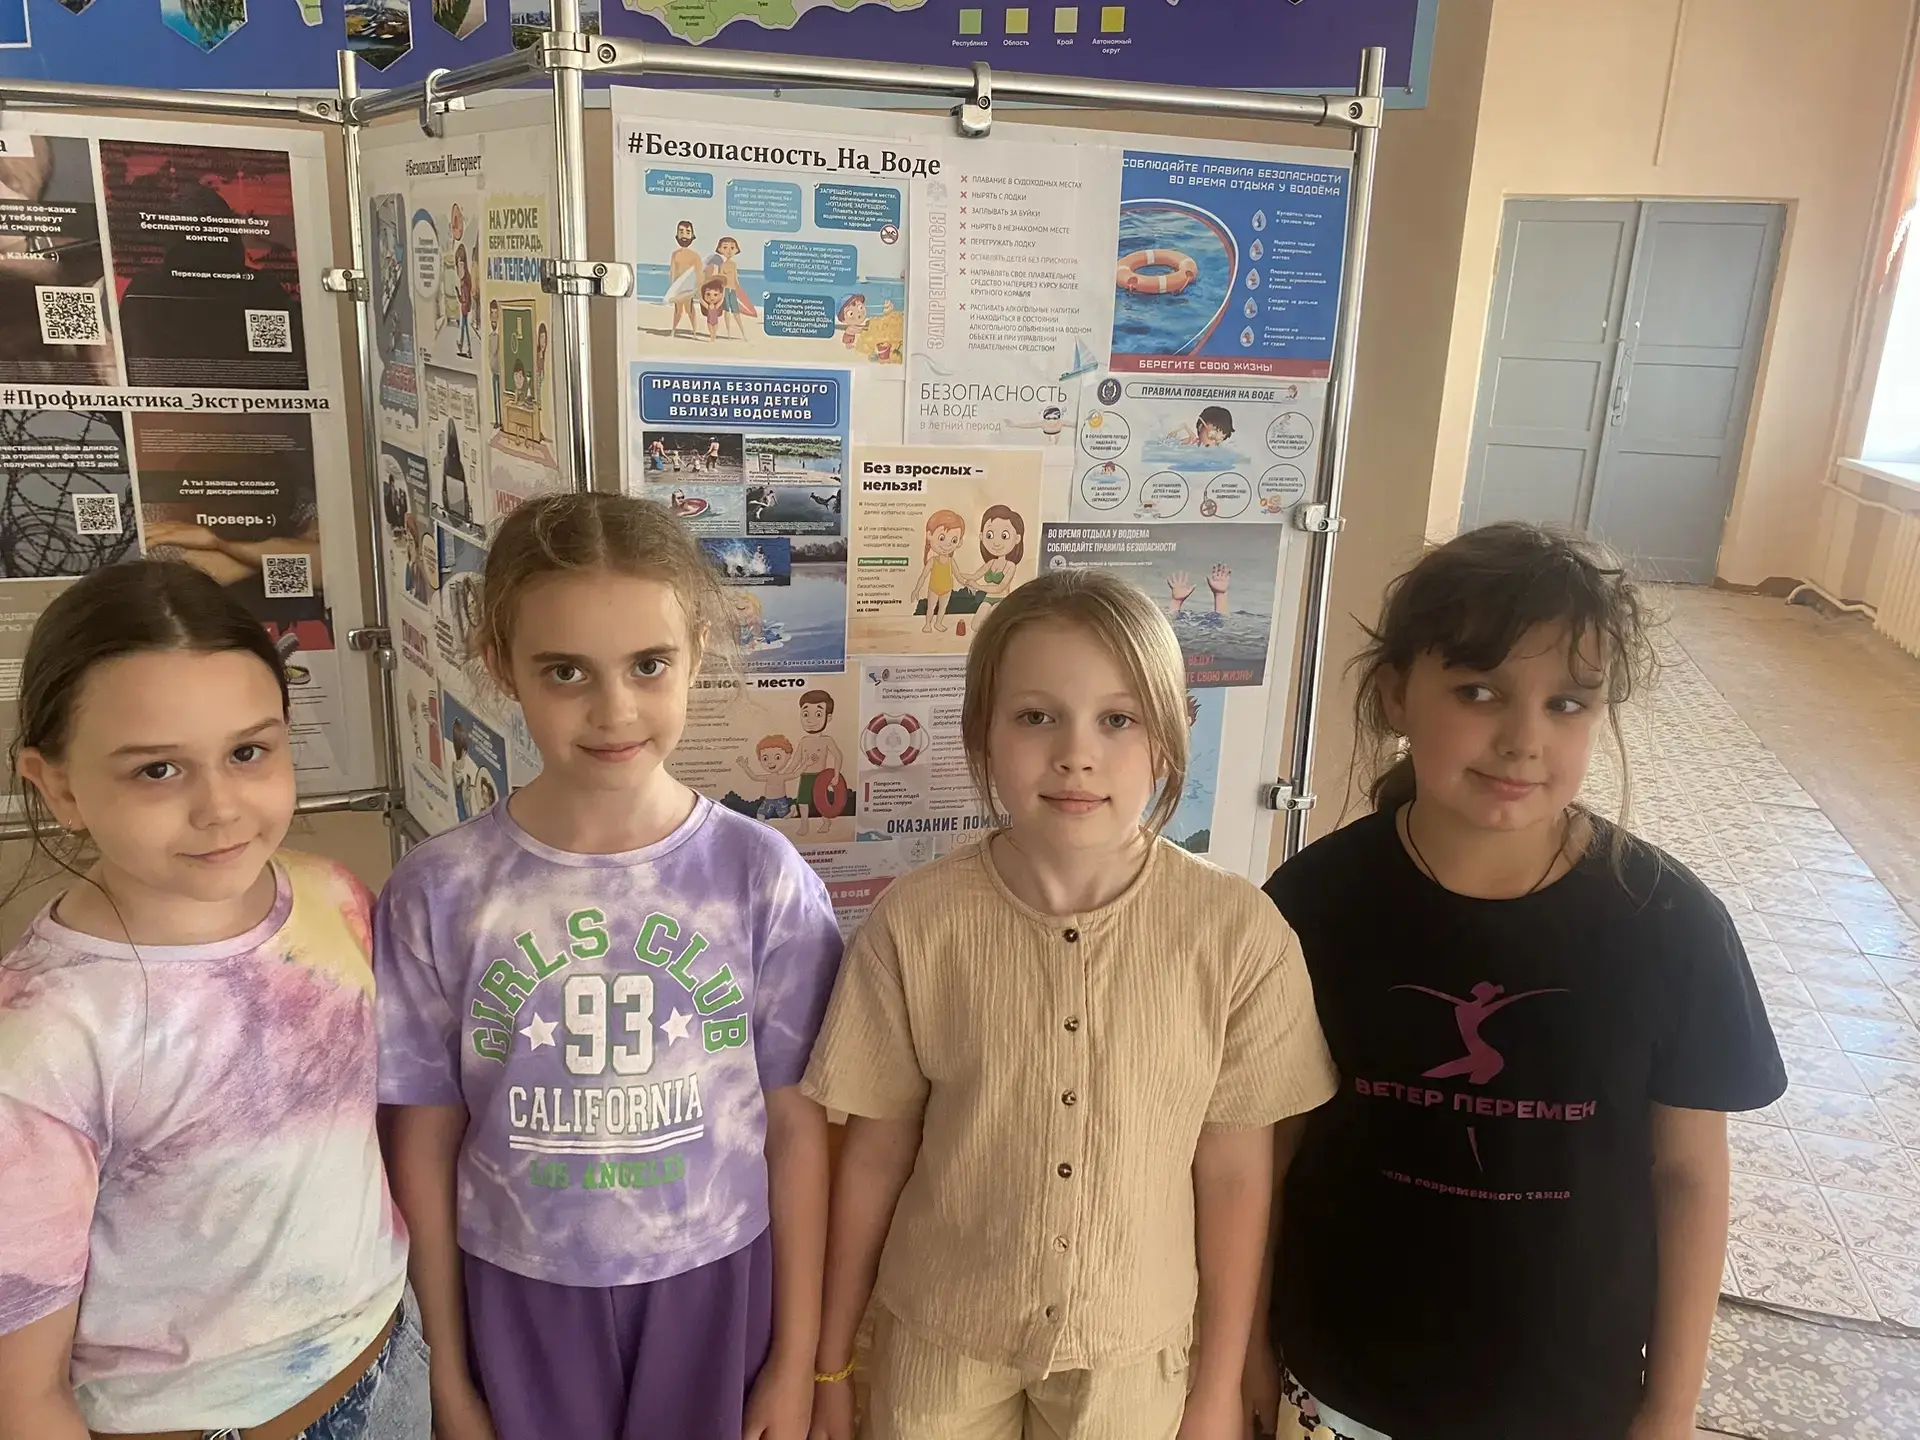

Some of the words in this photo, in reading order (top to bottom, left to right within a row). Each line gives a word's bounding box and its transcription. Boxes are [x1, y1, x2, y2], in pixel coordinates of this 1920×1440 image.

[952, 39, 988, 48] Республика
[1002, 38, 1030, 47] Область
[1056, 38, 1074, 46] Край
[1091, 38, 1133, 46] Автономный
[627, 132, 941, 179] #Безопасность_На_Воде
[406, 154, 482, 177] #Безопасный_Интернет
[1122, 158, 1199, 173] СОБЛЮДАЙТЕ
[1202, 164, 1254, 178] ПРАВИЛА
[1257, 168, 1342, 184] БЕЗОПАСНОСТИ
[972, 175, 1007, 185] ПЛАВАНИЕ
[1008, 177, 1013, 185] В
[1013, 179, 1058, 187] СУДОХОДНЫХ
[1058, 180, 1083, 189] МЕСТАХ
[1169, 175, 1184, 185] ВО
[1188, 176, 1227, 188] ВРЕМЯ
[1229, 180, 1275, 192] ОТДЫХА
[1278, 183, 1287, 192] У
[1289, 184, 1341, 197] ВОДОЁМА
[971, 191, 997, 200] НЫРЯТЬ
[1003, 193, 1027, 201] ЛОДКИ
[27, 205, 77, 214] кое-каких
[971, 206, 1009, 216] ЗАПЛЫВАТЬ
[1009, 208, 1018, 216] ЗА
[1018, 208, 1041, 218] БУЙКИ
[9, 214, 32, 222] тебя
[34, 215, 63, 224] могут
[139, 212, 156, 221] Тут
[158, 215, 199, 223] недавно
[200, 216, 246, 226] обновили
[248, 218, 269, 227] базу
[489, 209, 501, 230] НА
[503, 207, 538, 229] УРОКЕ
[140, 222, 201, 233] бесплатного
[203, 226, 271, 236] запрещенного
[970, 223, 997, 231] НЫРЯТЬ
[1003, 224, 1048, 233] НЕЗНАКОМОМ
[1049, 226, 1070, 234] МЕСТЕ
[186, 235, 229, 243] контента
[489, 235, 506, 250] БЕРИ
[970, 237, 1013, 247] ПЕРЕГРУЖАТЬ
[1013, 240, 1036, 248] ЛОДКУ
[7, 252, 46, 261] каких
[970, 253, 1005, 262] ОСТАВЛЯТЬ
[1005, 254, 1027, 263] ДЕТЕЙ
[1027, 256, 1040, 264] БЕЗ
[1040, 256, 1079, 265] ПРИСМОТРА
[171, 270, 212, 279] Переходи
[213, 272, 241, 280] скорей
[487, 257, 492, 280] А
[493, 257, 503, 281] НЕ
[970, 268, 1010, 277] НАПРАВЛЯТЬ
[1010, 270, 1027, 278] СВОЕ
[1028, 271, 1076, 280] ПЛАВАТЕЛЬНОЕ
[926, 212, 949, 350] ЗАПРЕЩАЕТСЯ
[970, 279, 1003, 287] СРЕДСТВО
[1003, 280, 1038, 289] НАПЕРЕРЕЗ
[1038, 281, 1058, 290] КУРСУ
[1058, 282, 1079, 290] БОЛЕЕ
[970, 289, 1003, 297] КРУПНОГО
[1003, 290, 1031, 298] КОРАБЛЯ
[970, 303, 1005, 312] РАСПИВАТЬ
[1005, 305, 1049, 314] АЛКОГОЛЬНЫЕ
[1050, 306, 1081, 315] НАПИТКИ
[975, 314, 1016, 322] НАХОДИТЬСЯ
[1022, 315, 1059, 324] СОСТОЯНИИ
[969, 323, 1017, 332] АЛКОГОЛЬНОГО
[1017, 325, 1055, 333] ОПЬЯНЕНИЯ
[1064, 326, 1092, 334] ВОДНОМ
[1016, 334, 1057, 342] УПРАВЛЕНИИ
[968, 342, 1018, 351] ПЛАВАТЕЛЬНЫМ
[1018, 344, 1055, 352] СРЕДСТВОМ
[1138, 359, 1196, 370] БЕРЕГИТЕ
[1199, 361, 1230, 371] СВОЮ
[1234, 363, 1273, 372] ЖИЗНЬ!
[652, 379, 722, 391] ПРАВИЛА
[726, 381, 828, 395] БЕЗОПАСНОГО
[921, 382, 1068, 403] БЕЗОПАСНОСТЬ
[1141, 386, 1183, 397] ПРАВИЛА
[1184, 387, 1237, 398] ПОВЕДЕНИЯ
[1238, 389, 1251, 399] НА
[1251, 391, 1275, 400] ВОДЕ
[3, 389, 330, 412] #Профилактика_Экстремизма
[672, 393, 760, 406] ПОВЕДЕНИЯ
[764, 394, 809, 407] ДЕТЕЙ
[669, 406, 729, 418] ВБЛИЗИ
[733, 408, 813, 421] ВОДОЕМОВ
[920, 403, 939, 417] НА
[943, 404, 979, 419] ВОДЕ
[920, 420, 926, 430] в
[928, 419, 965, 431] летний
[968, 421, 1002, 433] период
[54, 444, 81, 452] война
[13, 453, 60, 461] отрицание
[62, 453, 94, 461] фактов
[104, 452, 120, 460] ней
[98, 460, 119, 468] дней
[862, 461, 892, 475] Без
[895, 463, 973, 478] взрослых
[862, 479, 923, 492] нельзя!
[206, 488, 280, 496] дискриминация?
[196, 513, 264, 527] Проверь
[1048, 528, 1058, 539] ВО
[1058, 528, 1082, 539] ВРЕМЯ
[1082, 528, 1111, 540] ОТДЫХА
[1112, 528, 1118, 539] У
[1118, 528, 1150, 540] ВОДОЕМА
[1047, 541, 1094, 553] СОБЛЮДАЙТЕ
[1094, 542, 1126, 552] ПРАВИЛА
[1126, 542, 1177, 552] БЕЗОПАСНОСТИ
[783, 658, 815, 668] Брянской
[1197, 670, 1221, 682] СВОЮ
[757, 678, 806, 688] место
[873, 780, 901, 788] Попросите
[902, 792, 920, 800] людей
[886, 816, 959, 834] ОКАЗАНИЕ
[840, 888, 871, 899] ВОДЕ
[471, 906, 611, 1067] GIRLS
[633, 911, 749, 1055] CLUB
[561, 972, 655, 1077] 93
[508, 1072, 705, 1136] CALIFORNIA
[1354, 1076, 1444, 1107] ВЕТЕР
[1453, 1093, 1598, 1122] ПЕРЕМЕН
[1414, 1177, 1523, 1201] современного
[1525, 1189, 1571, 1200] танца
